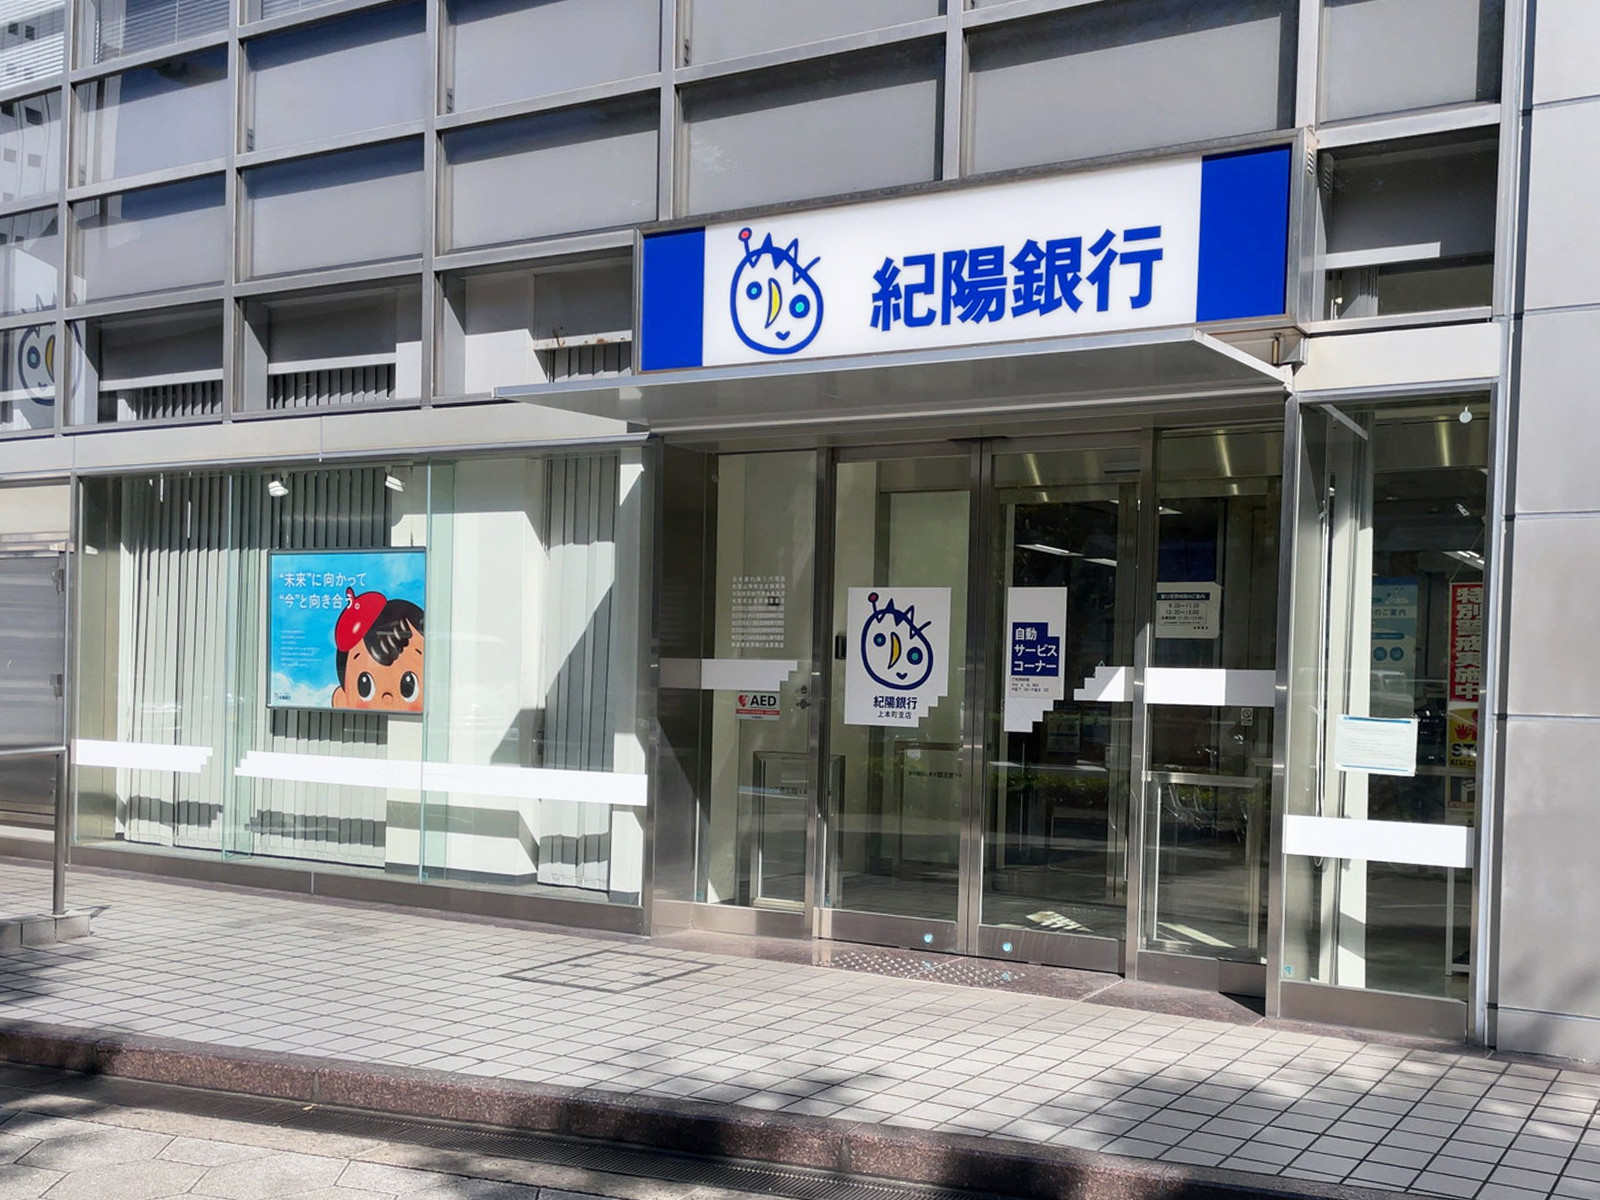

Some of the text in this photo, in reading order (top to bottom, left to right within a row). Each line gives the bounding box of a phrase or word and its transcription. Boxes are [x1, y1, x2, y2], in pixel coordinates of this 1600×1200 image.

[869, 224, 1163, 332] 紀陽銀行
[1014, 627, 1038, 642] 自動
[1013, 643, 1058, 657] サービス
[1013, 659, 1057, 673] コーナー
[750, 694, 777, 707] AED
[873, 695, 918, 710] 紀陽銀行
[877, 711, 912, 719] 上本町支店
[1451, 743, 1478, 758] ST
